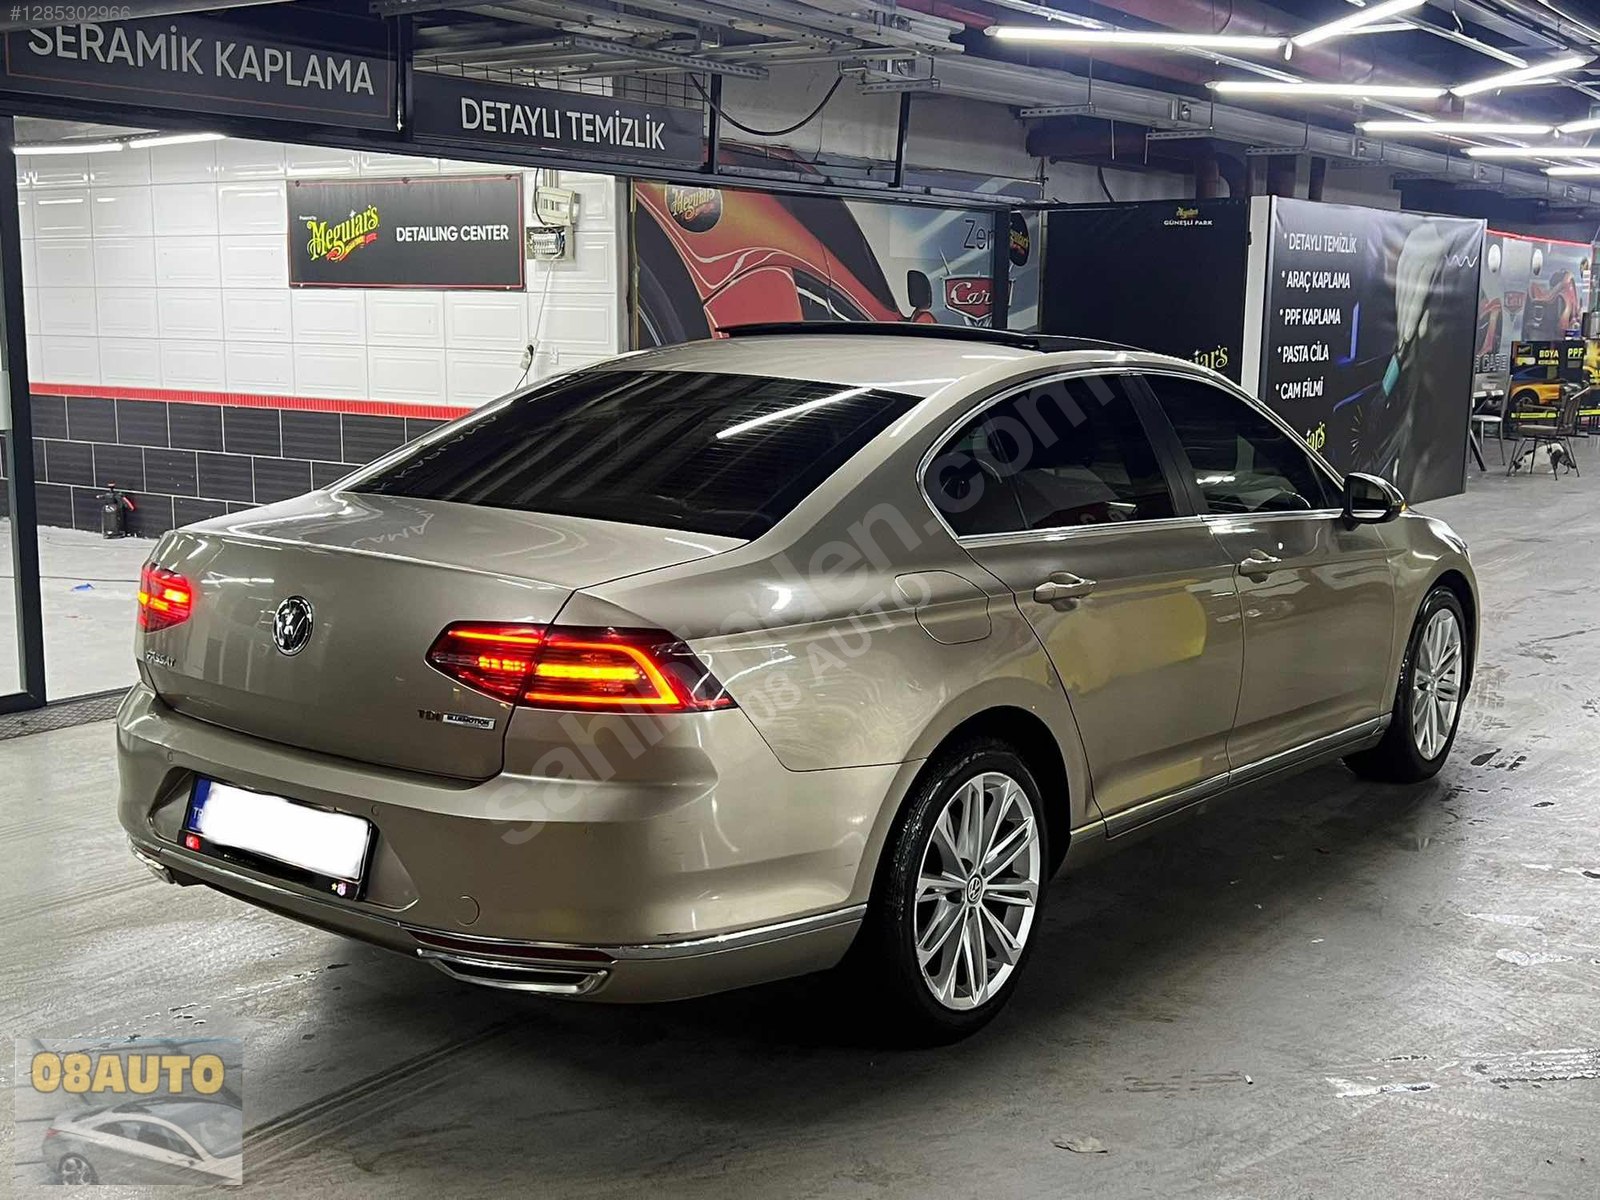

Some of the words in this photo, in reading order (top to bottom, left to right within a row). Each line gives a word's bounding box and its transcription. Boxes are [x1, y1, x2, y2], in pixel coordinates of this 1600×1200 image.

[28, 23, 203, 75] SERAMİK
[215, 41, 375, 96] KAPLAMA
[460, 97, 561, 139] DETAYLI
[566, 110, 666, 150] TEMİZLİK
[396, 225, 459, 243] DETAILING
[460, 224, 509, 242] CENTER
[1289, 233, 1322, 252] DETAYLI
[1323, 232, 1357, 254] TEMİZLİK
[1286, 271, 1311, 293] ARAÇ
[1312, 271, 1351, 289] KAPLAMA
[1284, 308, 1302, 326] PPF
[1302, 308, 1341, 326] KAPLAMA
[1282, 345, 1309, 363] PASTA
[1309, 340, 1329, 362] CİLA
[1539, 349, 1559, 358] BOYA
[1567, 347, 1584, 359] PPF
[1280, 382, 1301, 400] CAM
[1302, 376, 1324, 398] FİLMİ
